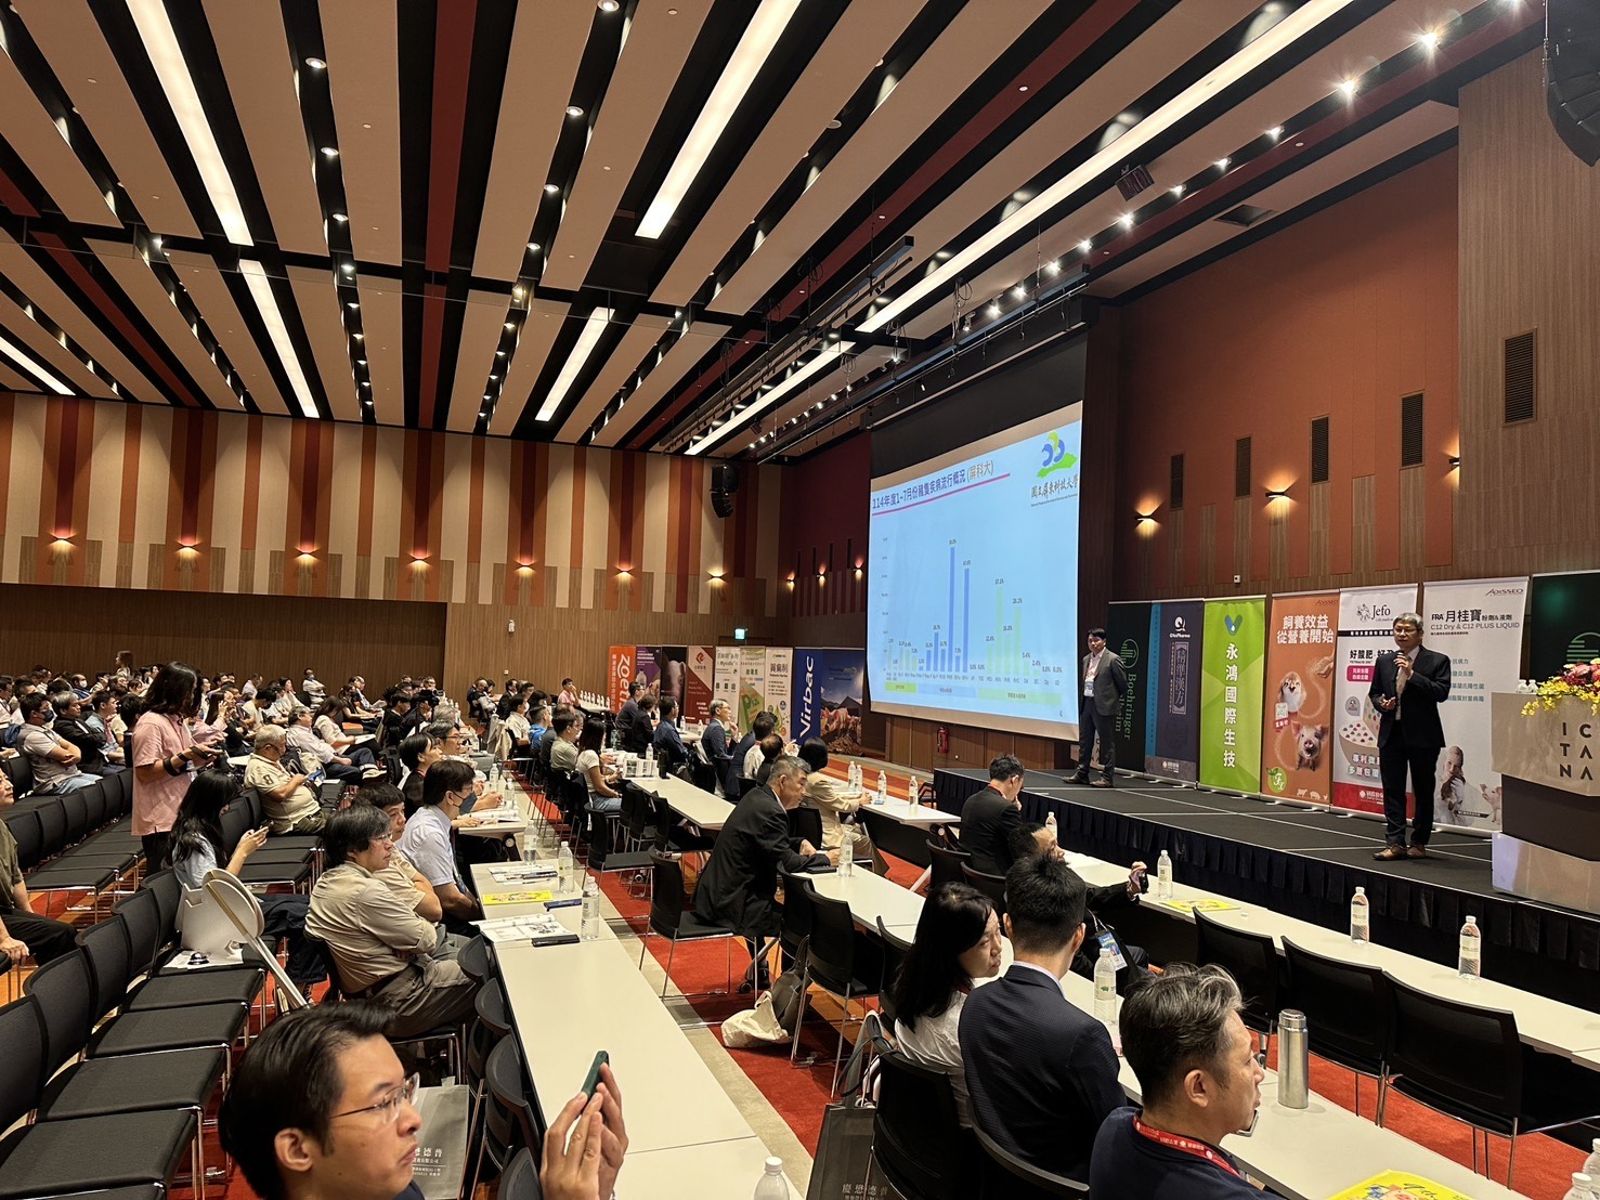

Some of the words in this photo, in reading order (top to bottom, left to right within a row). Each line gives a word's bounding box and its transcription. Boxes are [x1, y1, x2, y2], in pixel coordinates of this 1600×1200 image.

[1371, 604, 1391, 620] Jefo
[1431, 613, 1444, 621] FRA
[1283, 614, 1328, 629] 飼養效益
[1496, 621, 1520, 630] LIQUID
[1277, 629, 1334, 644] 從營養開始
[799, 655, 814, 738] Virbac
[1123, 674, 1137, 740] Boehringer
